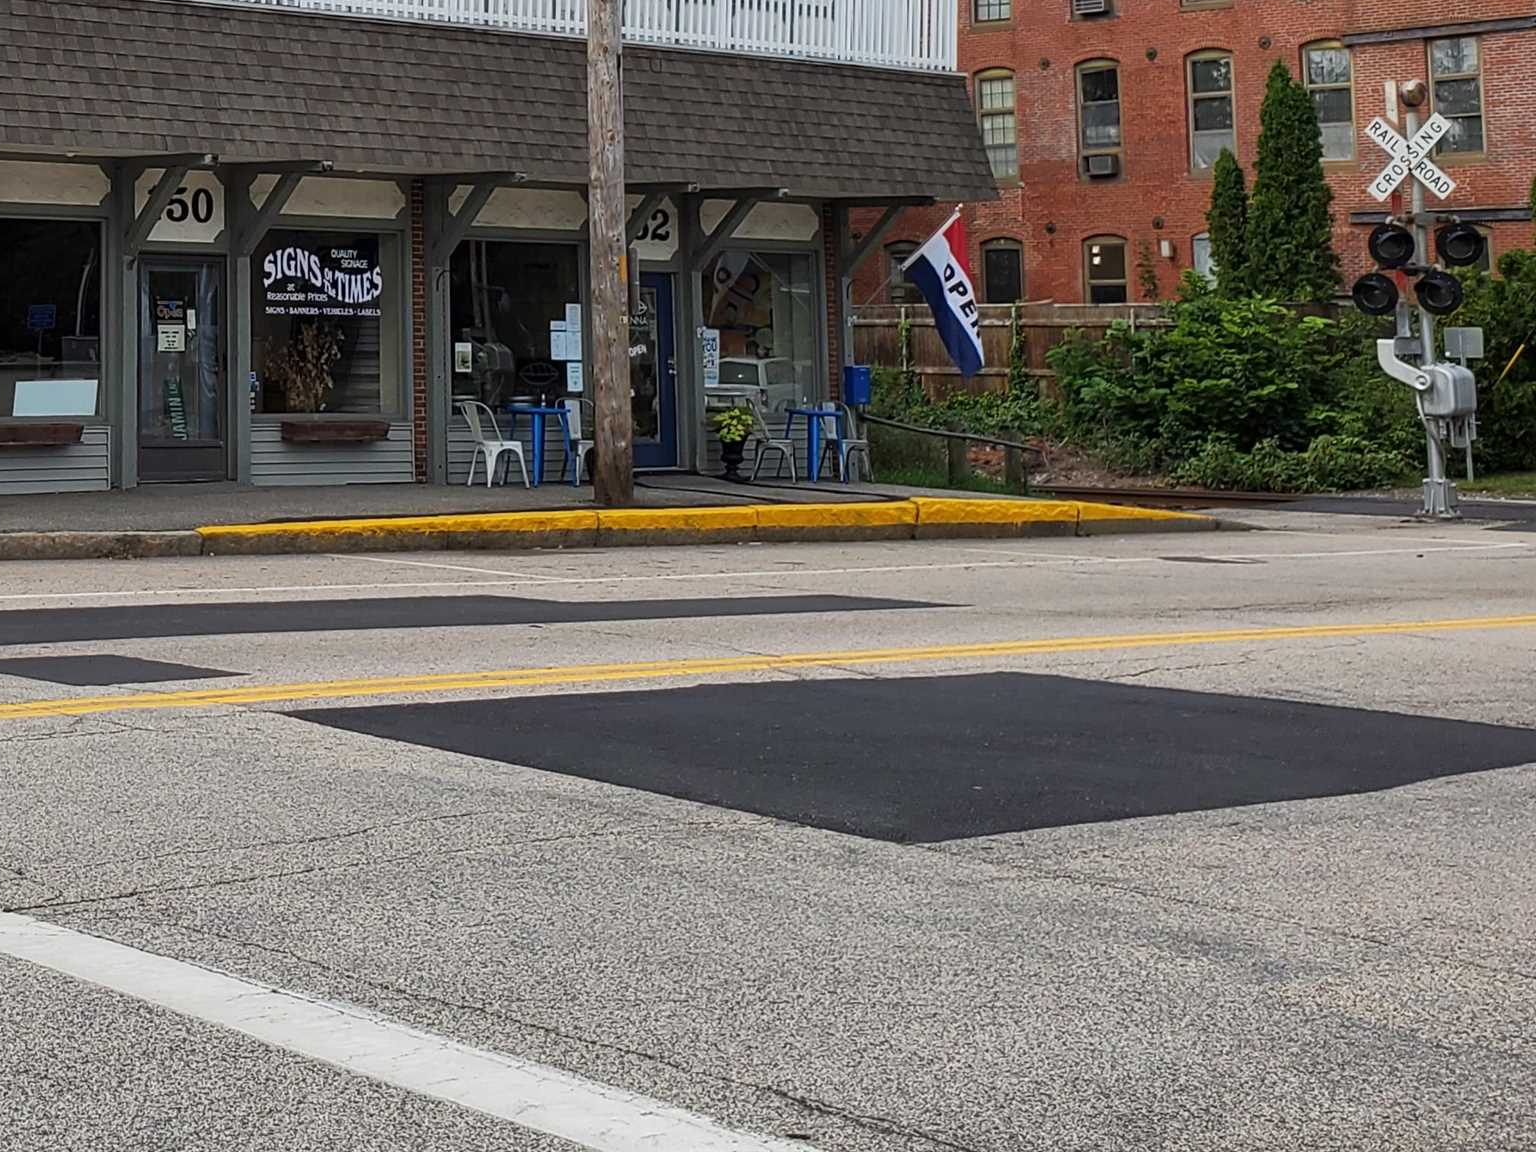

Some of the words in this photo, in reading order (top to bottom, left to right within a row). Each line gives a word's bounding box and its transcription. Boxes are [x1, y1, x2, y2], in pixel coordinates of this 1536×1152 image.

[1369, 121, 1400, 153] RAIL
[1415, 161, 1450, 194] ROAD
[1375, 121, 1443, 194] CROSSING
[263, 247, 323, 288] SIGNS
[330, 249, 358, 259] QUALITY
[334, 265, 383, 304] TIMES
